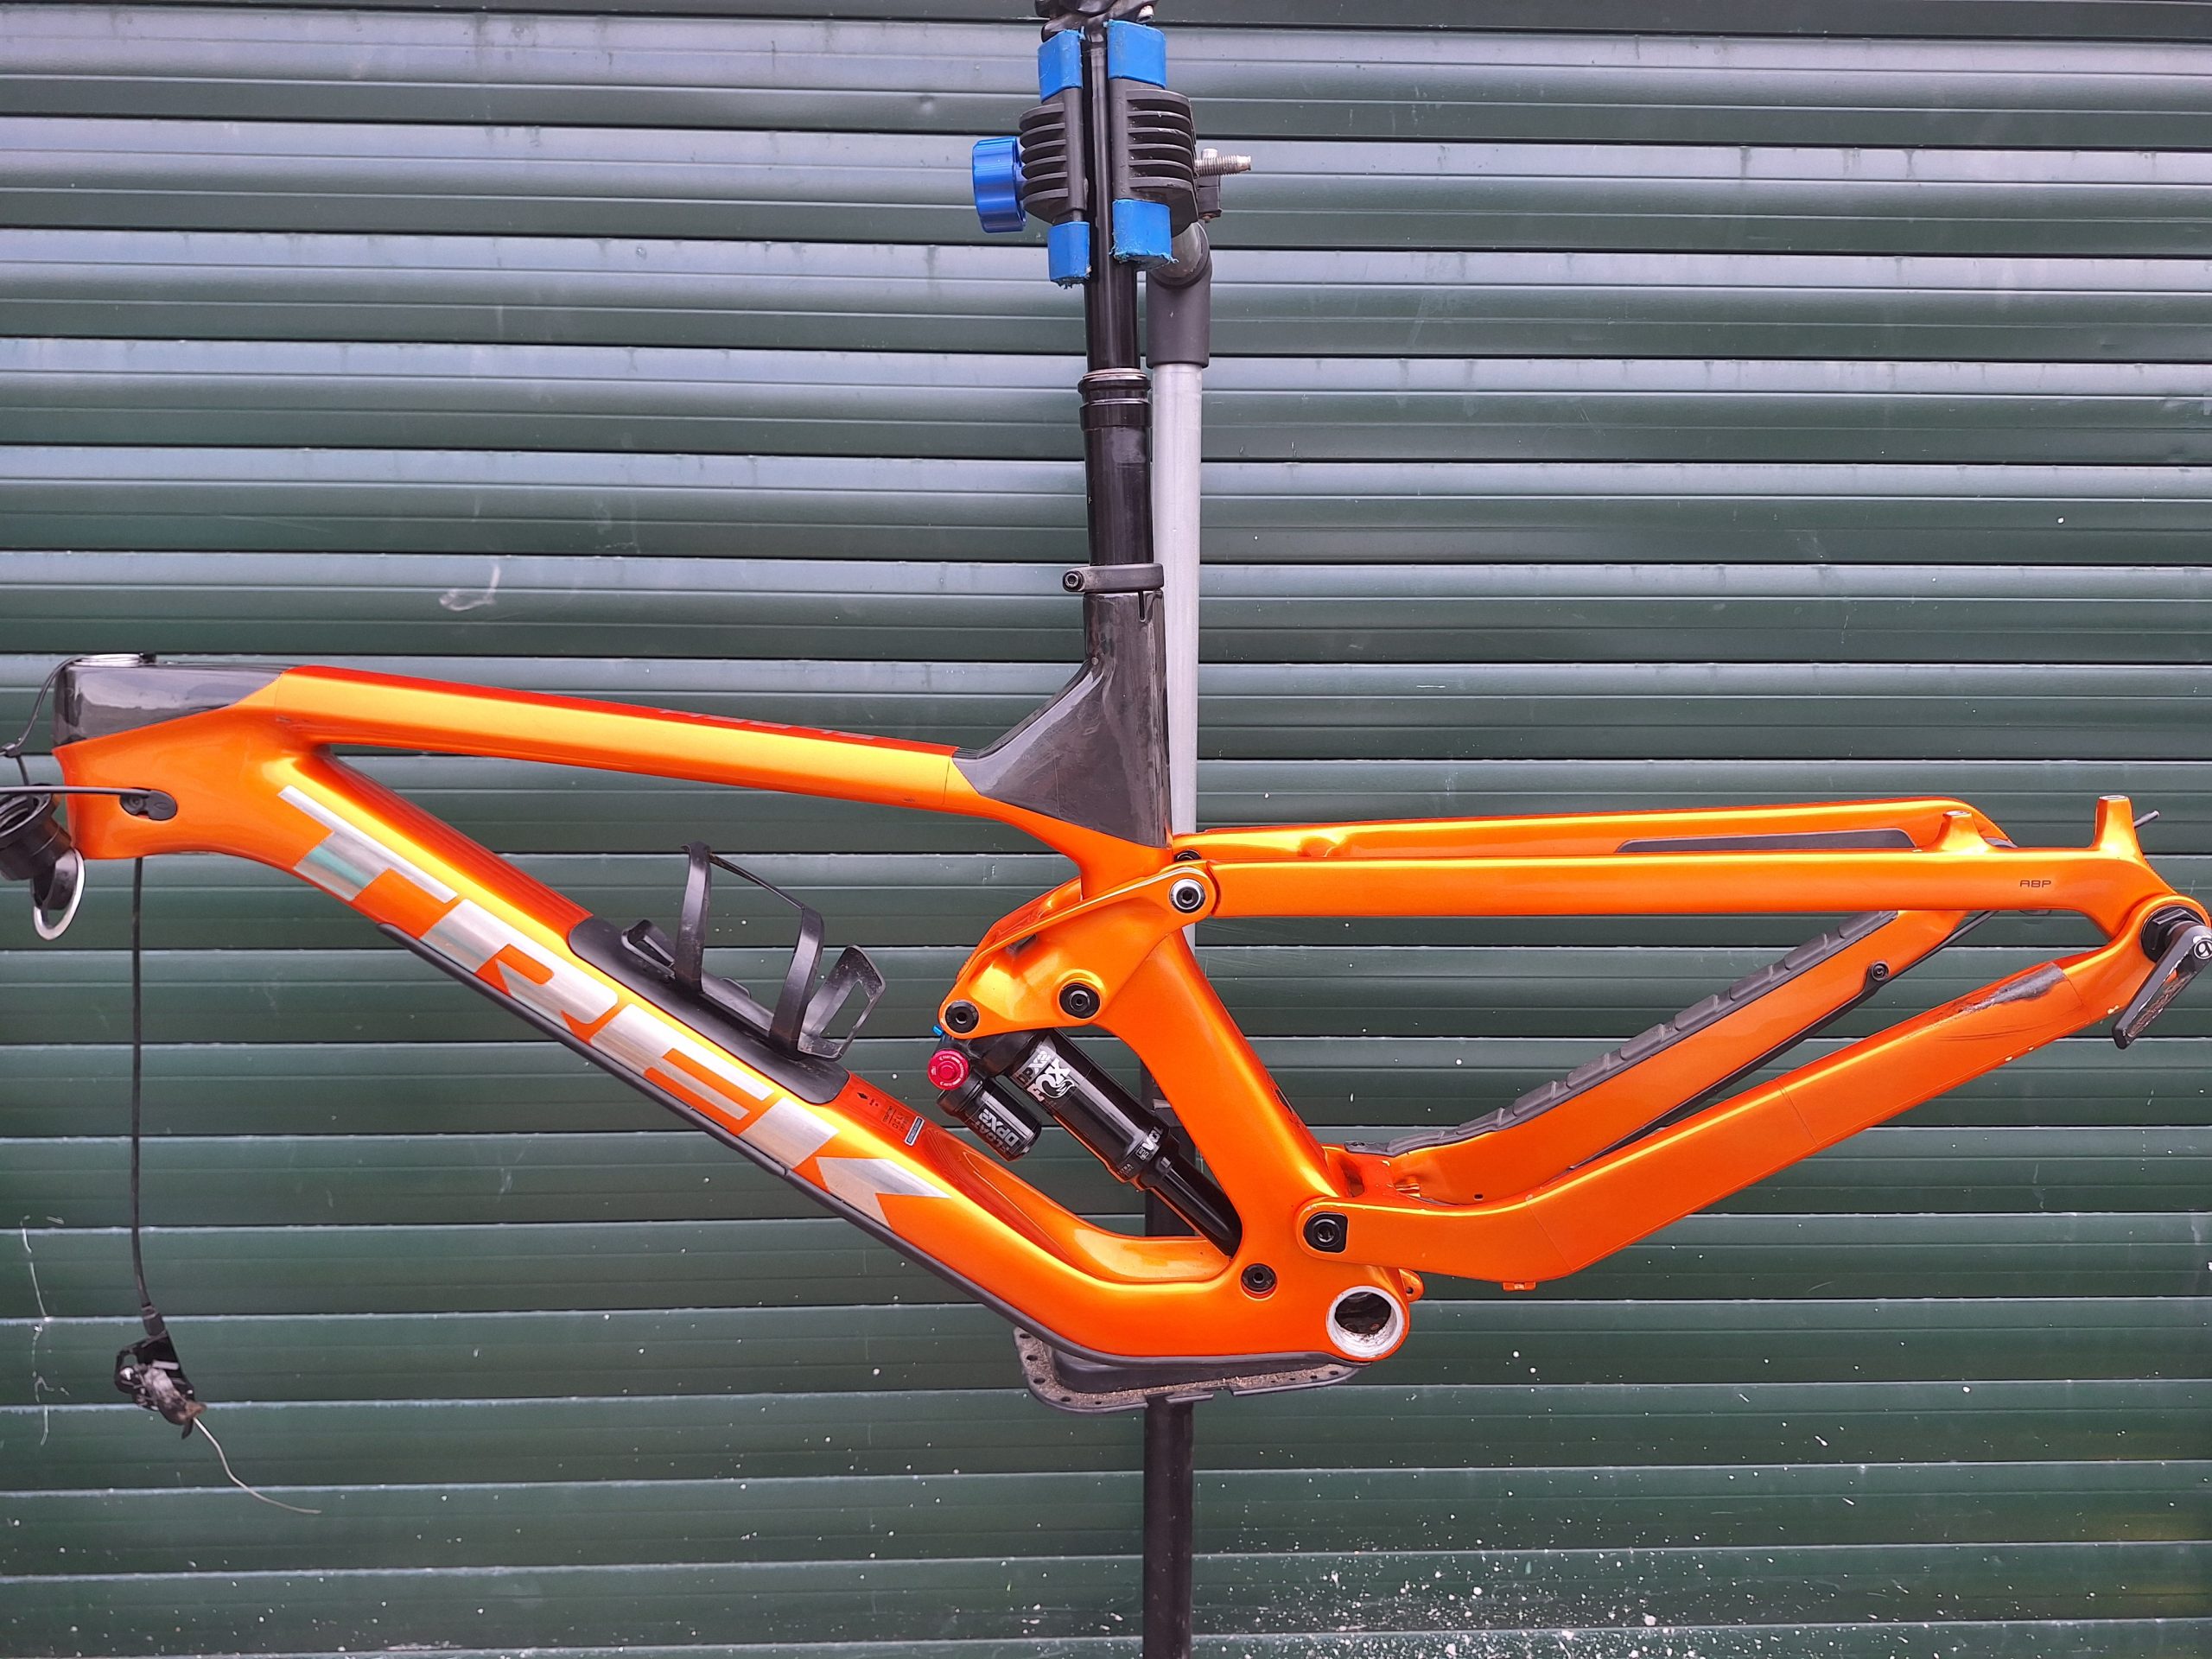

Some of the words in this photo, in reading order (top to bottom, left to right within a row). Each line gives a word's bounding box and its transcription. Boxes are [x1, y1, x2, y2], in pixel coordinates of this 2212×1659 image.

[278, 785, 952, 1227] TREK
[1027, 1058, 1074, 1102] FOX
[970, 1120, 1010, 1154] FLOAT
[977, 1108, 1020, 1147] DPX2
